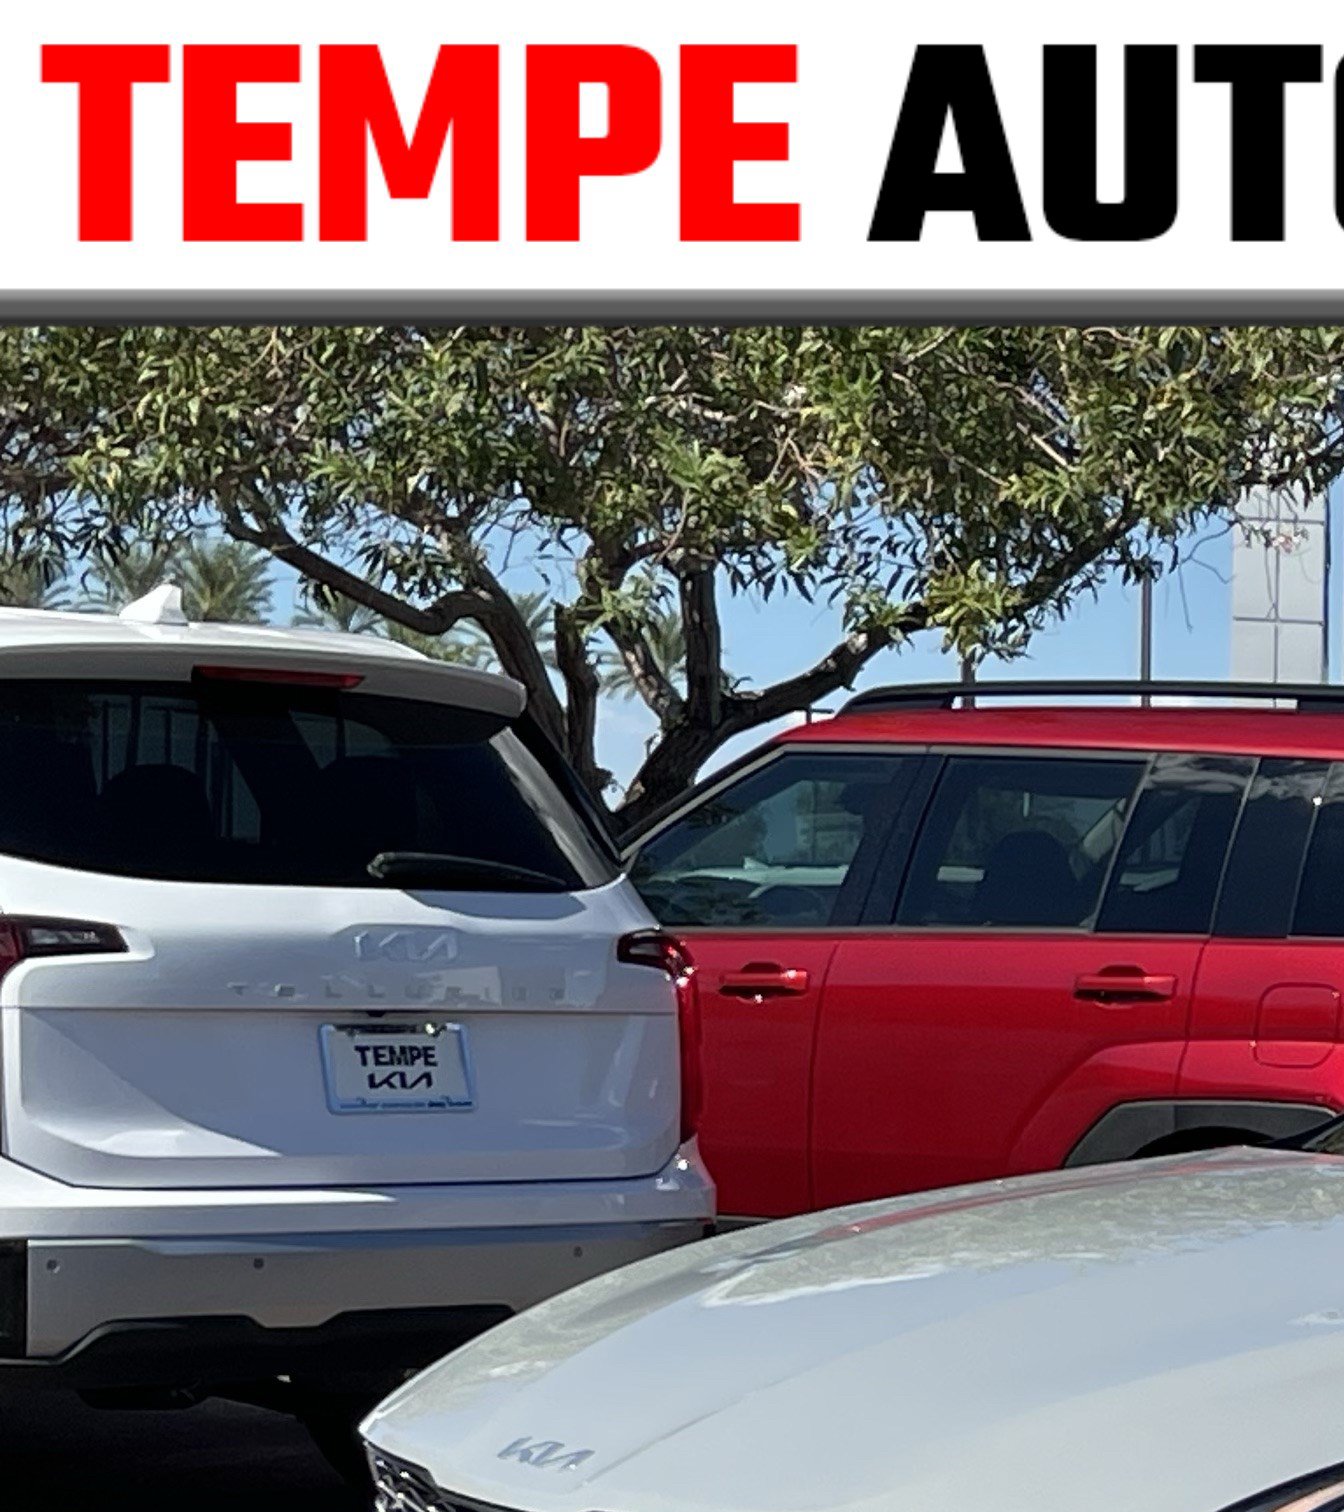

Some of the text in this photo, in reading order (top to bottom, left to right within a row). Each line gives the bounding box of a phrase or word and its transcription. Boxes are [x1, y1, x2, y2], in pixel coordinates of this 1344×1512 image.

[354, 1045, 438, 1067] TEMPE
[367, 1071, 433, 1089] KIA
[497, 1436, 596, 1471] KIA
